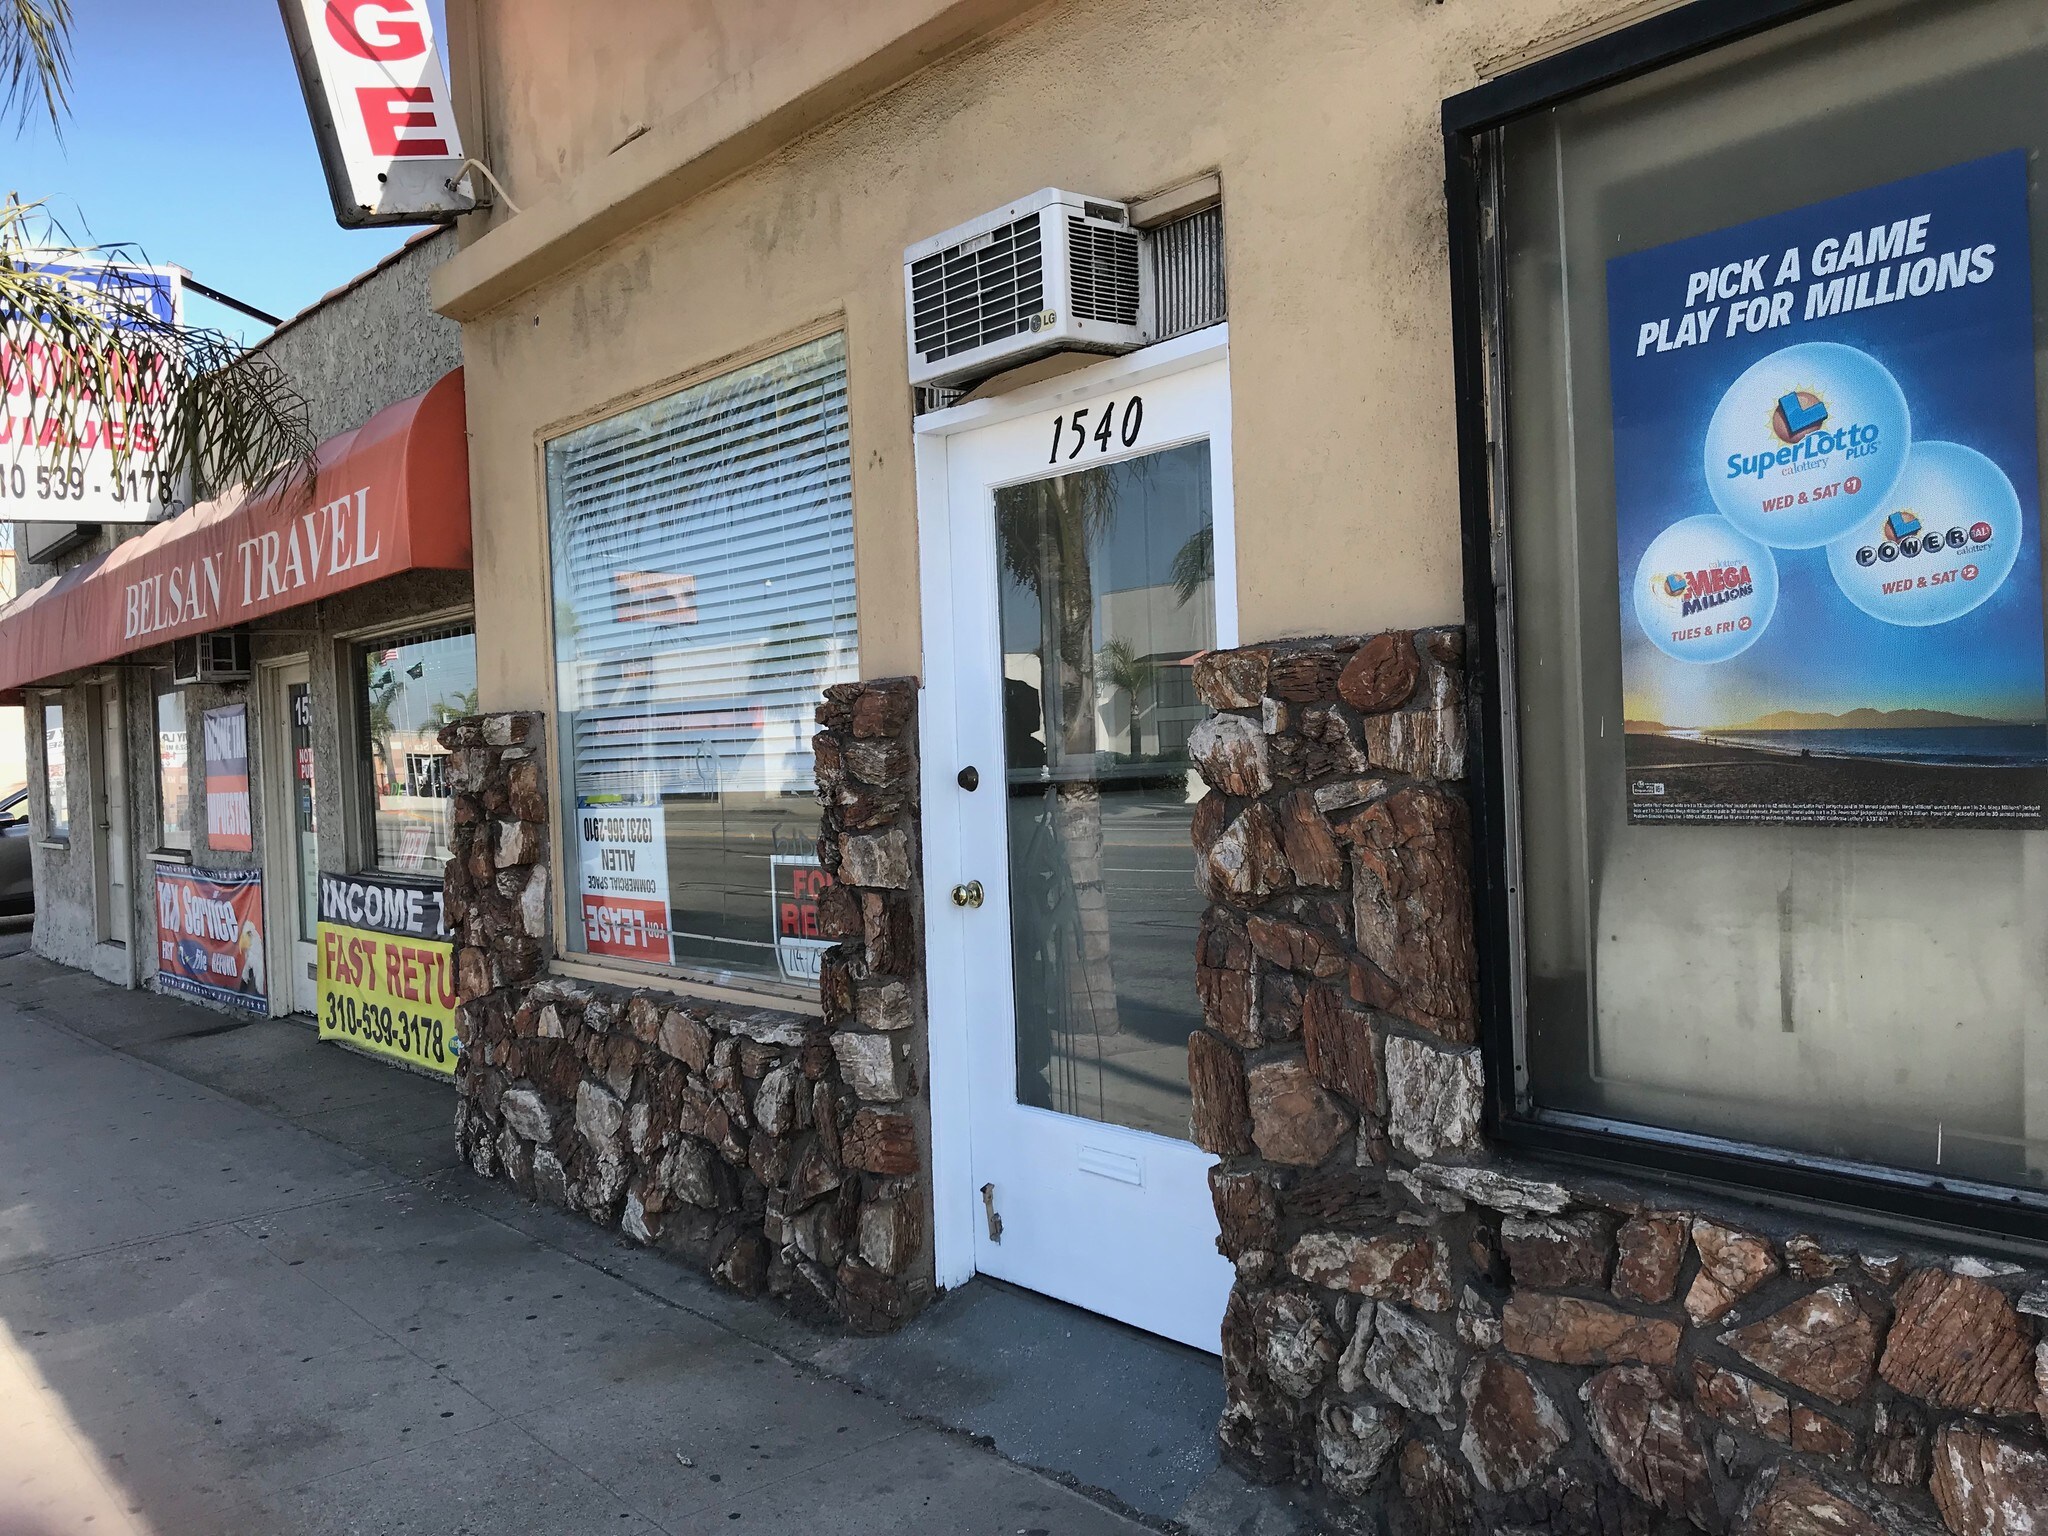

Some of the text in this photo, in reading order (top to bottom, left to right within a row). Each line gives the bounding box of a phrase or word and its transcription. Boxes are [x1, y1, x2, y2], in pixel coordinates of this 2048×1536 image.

[1685, 213, 1931, 307] PICK A GAME
[1637, 244, 1996, 357] PLAY FOR MILLIONS
[1043, 312, 1055, 326] LG
[1049, 396, 1143, 464] 1540
[1727, 423, 1879, 480] SuperLotto
[1781, 458, 1829, 477] calottery
[1845, 443, 1879, 461] PLUS
[37, 466, 84, 501] 539
[110, 468, 173, 504] 3178
[1763, 494, 1794, 513] WED
[1798, 491, 1809, 504] &
[1813, 482, 1841, 501] SAT
[125, 486, 380, 641] BELSAN TRAVEL
[1684, 565, 1752, 600] MEGA
[1882, 579, 1913, 595] WED
[1917, 576, 1927, 588] &
[1931, 569, 1959, 586] SAT
[1682, 585, 1754, 618] MILLIONS
[1671, 627, 1702, 642] TUES
[1704, 625, 1713, 636] &
[1716, 621, 1735, 634] FRI
[584, 817, 625, 843] 366-2910
[601, 849, 635, 872] ALLEN
[588, 875, 656, 894] COMMERCIAL SPACE
[793, 869, 834, 901] FO
[182, 885, 239, 943] Service
[322, 878, 425, 933] INCOME
[781, 903, 828, 938] RE
[585, 905, 648, 948] LEASE
[325, 931, 457, 1010] FAST RETU
[325, 991, 445, 1063] 310-539-3178
